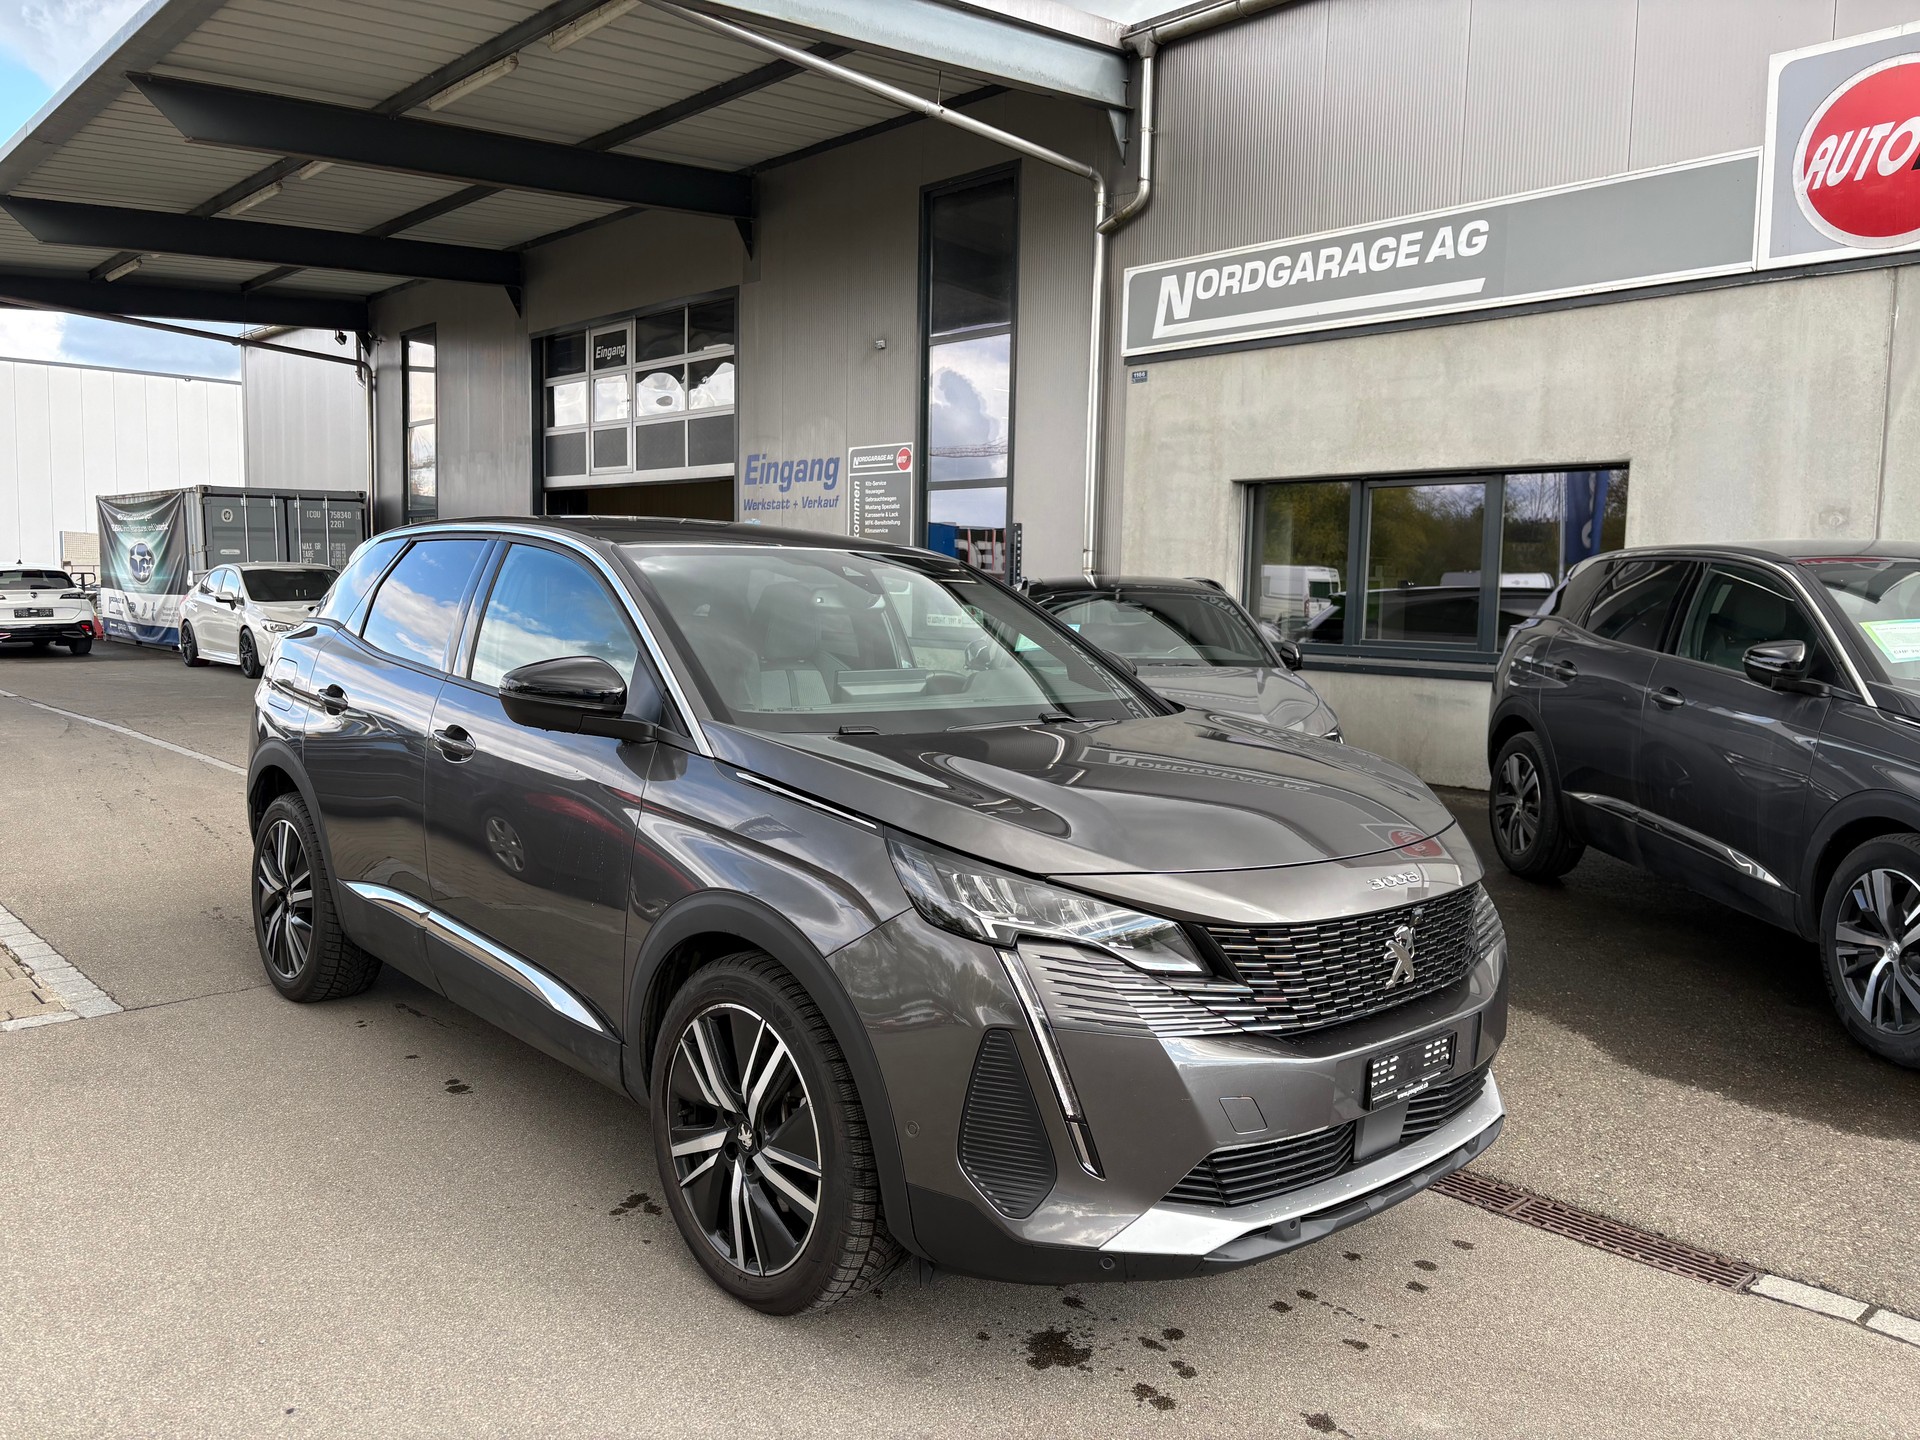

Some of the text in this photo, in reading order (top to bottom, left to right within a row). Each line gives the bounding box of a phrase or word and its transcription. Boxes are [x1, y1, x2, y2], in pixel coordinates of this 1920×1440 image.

[1804, 116, 1920, 192] AUTO
[1153, 220, 1489, 322] NORDGARAGE AG
[596, 345, 626, 360] Eingang
[853, 455, 887, 467] NORDGARAGE
[744, 454, 840, 492] Eingang
[743, 495, 840, 511] Werkstatt + Verkauf
[330, 510, 351, 519] 758340
[330, 520, 345, 528] 22G1
[1366, 871, 1420, 890] 3008
